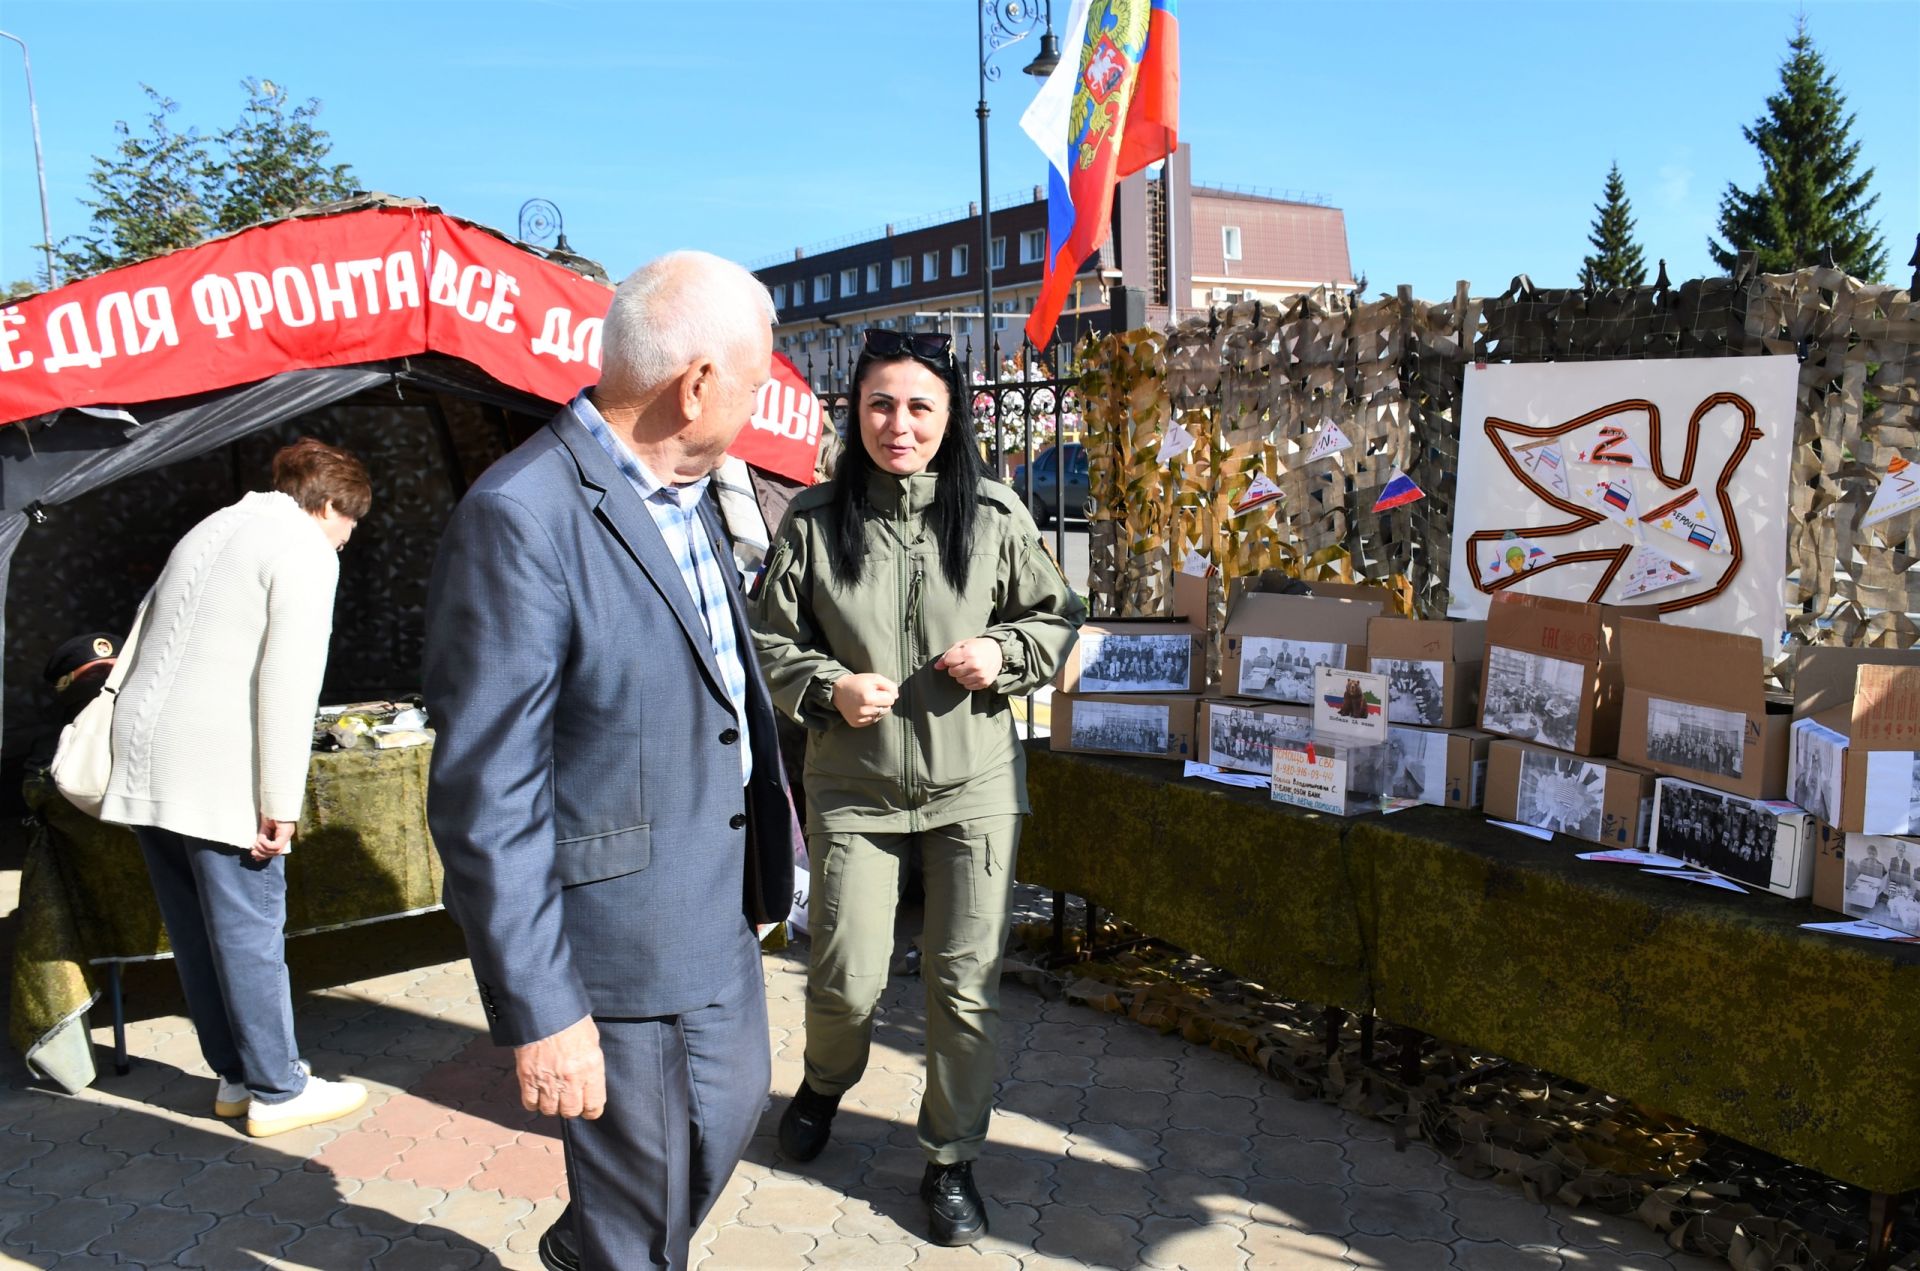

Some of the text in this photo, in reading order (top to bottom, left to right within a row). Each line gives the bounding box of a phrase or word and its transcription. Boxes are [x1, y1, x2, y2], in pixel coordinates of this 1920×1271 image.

[0, 248, 820, 446] Ё ДЛЯ ФРОНТА ВСЁ ДЛ ДЫ!
